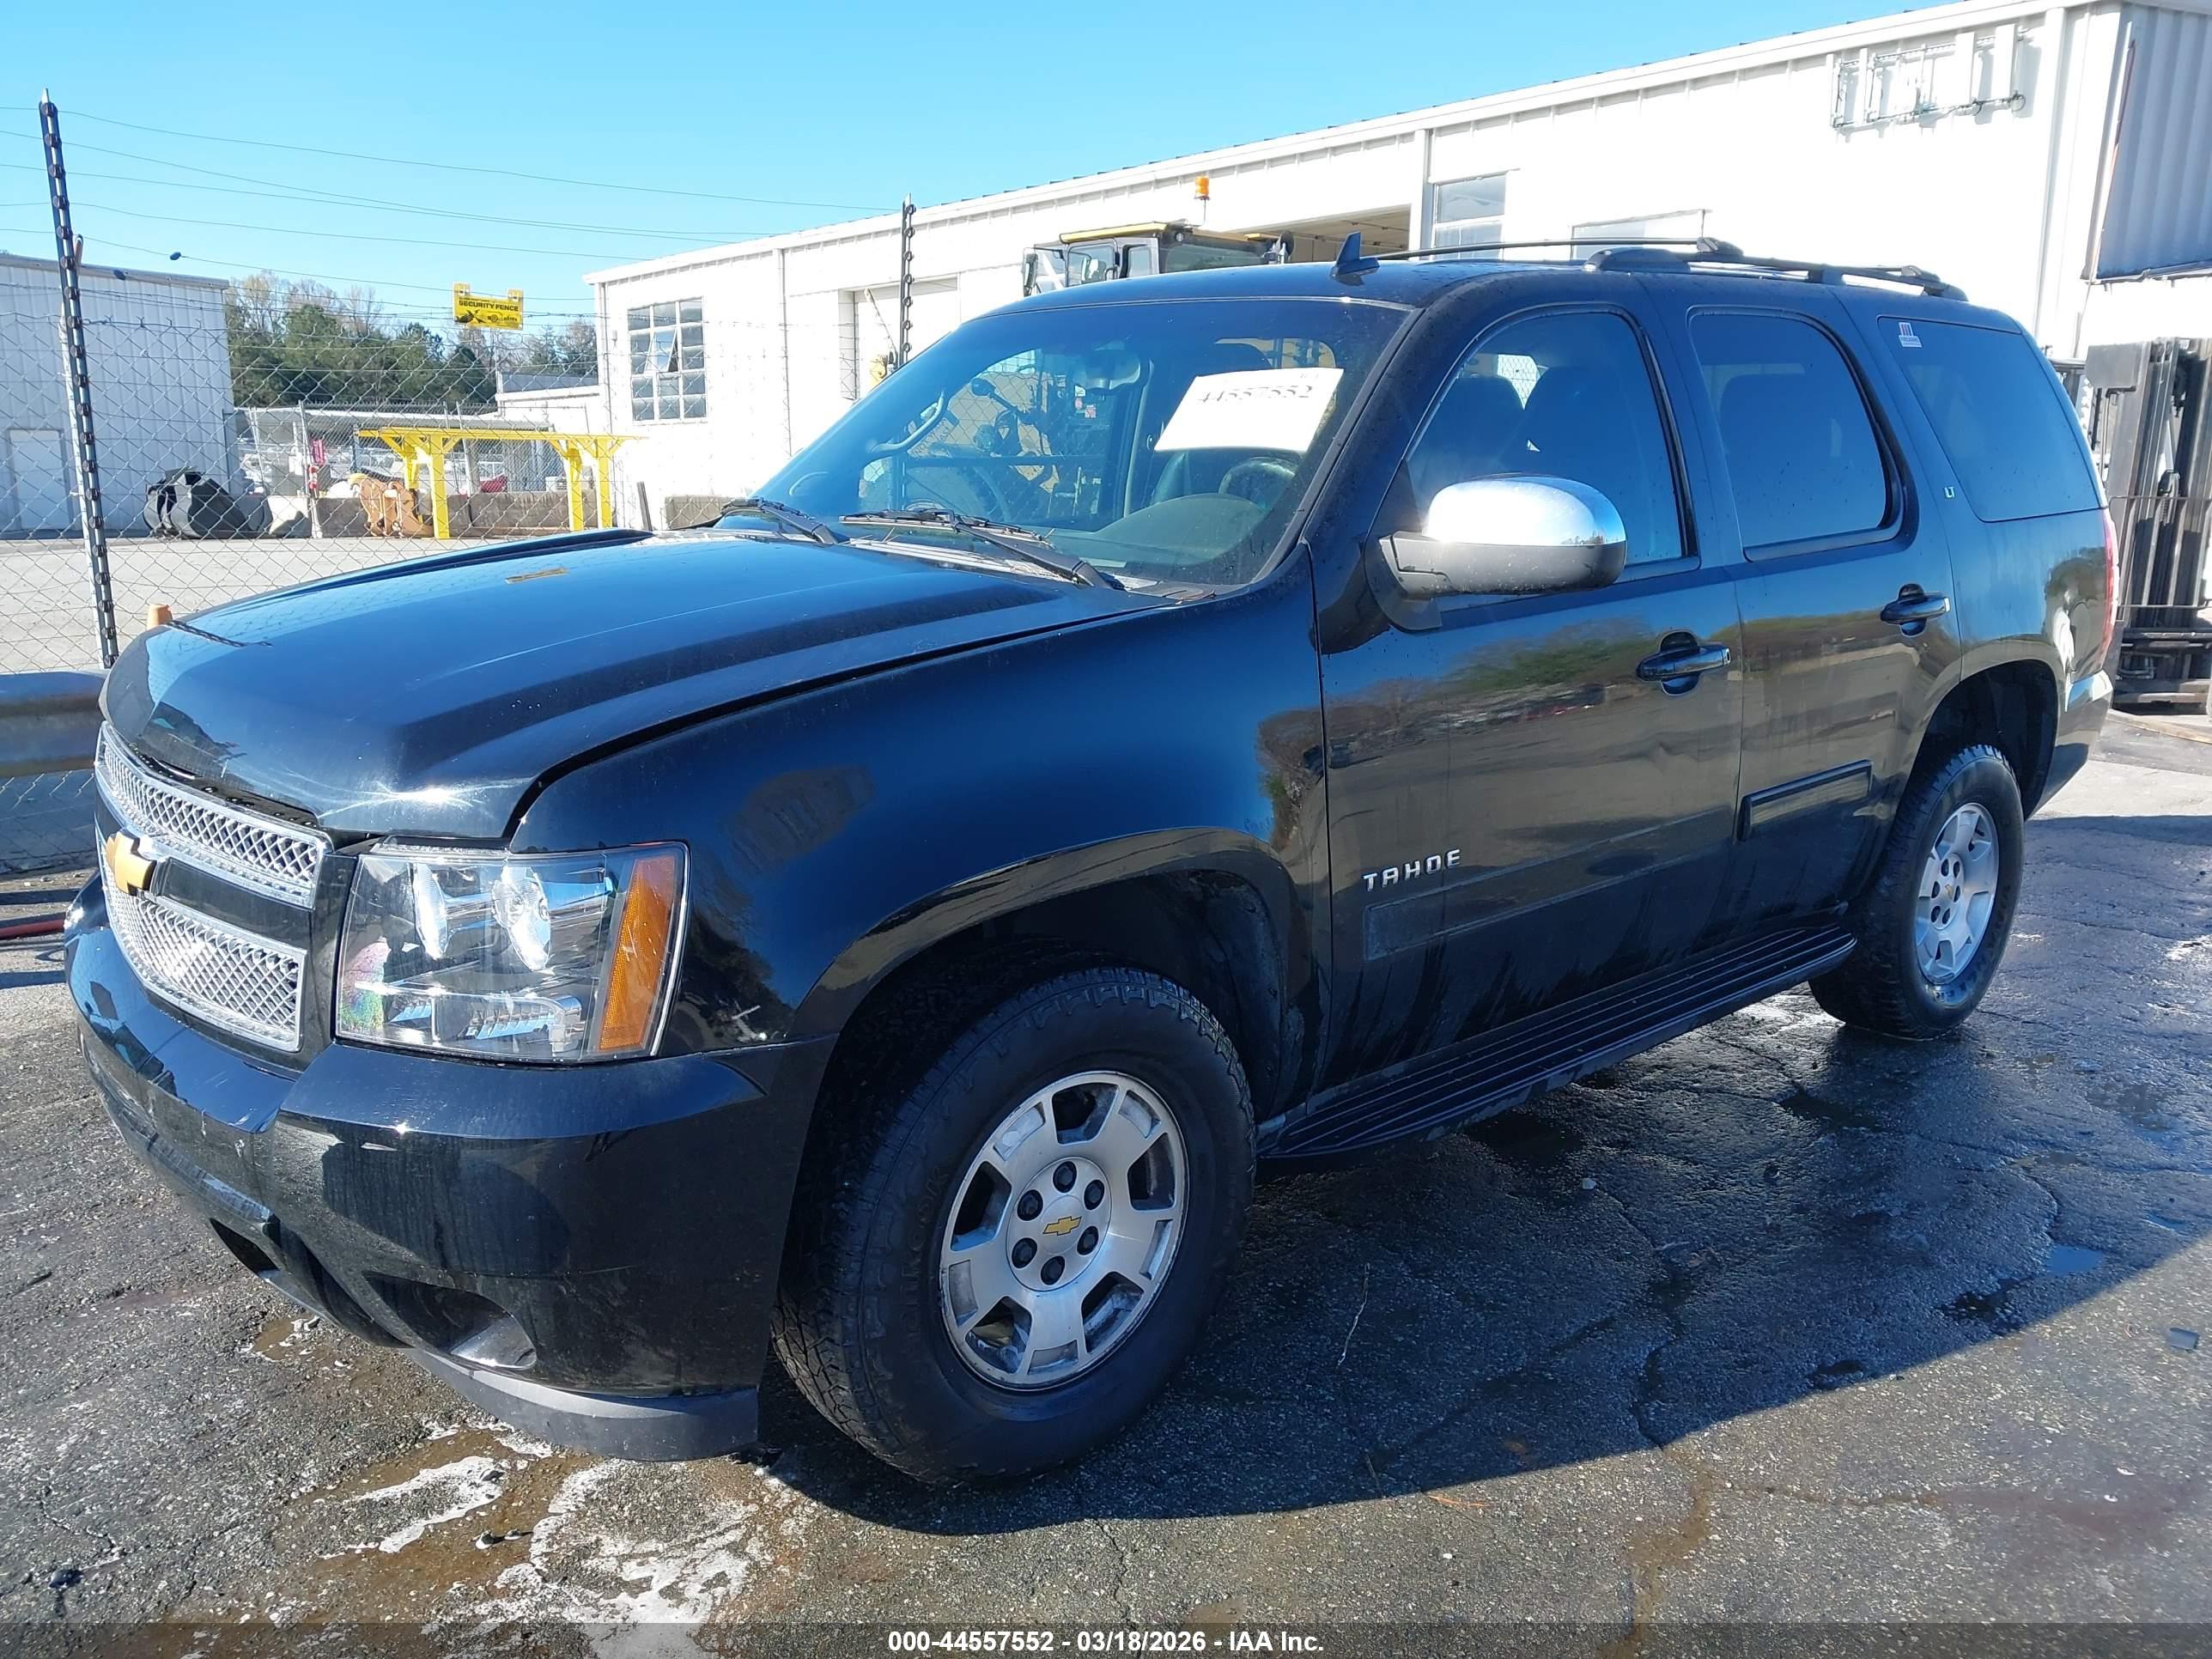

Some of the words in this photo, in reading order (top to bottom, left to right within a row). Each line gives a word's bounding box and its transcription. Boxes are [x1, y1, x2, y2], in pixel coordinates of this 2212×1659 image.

[459, 300, 495, 309] SECURITY
[495, 302, 519, 311] FENCE
[1944, 486, 1956, 498] LT
[1363, 848, 1461, 892] TAHOE
